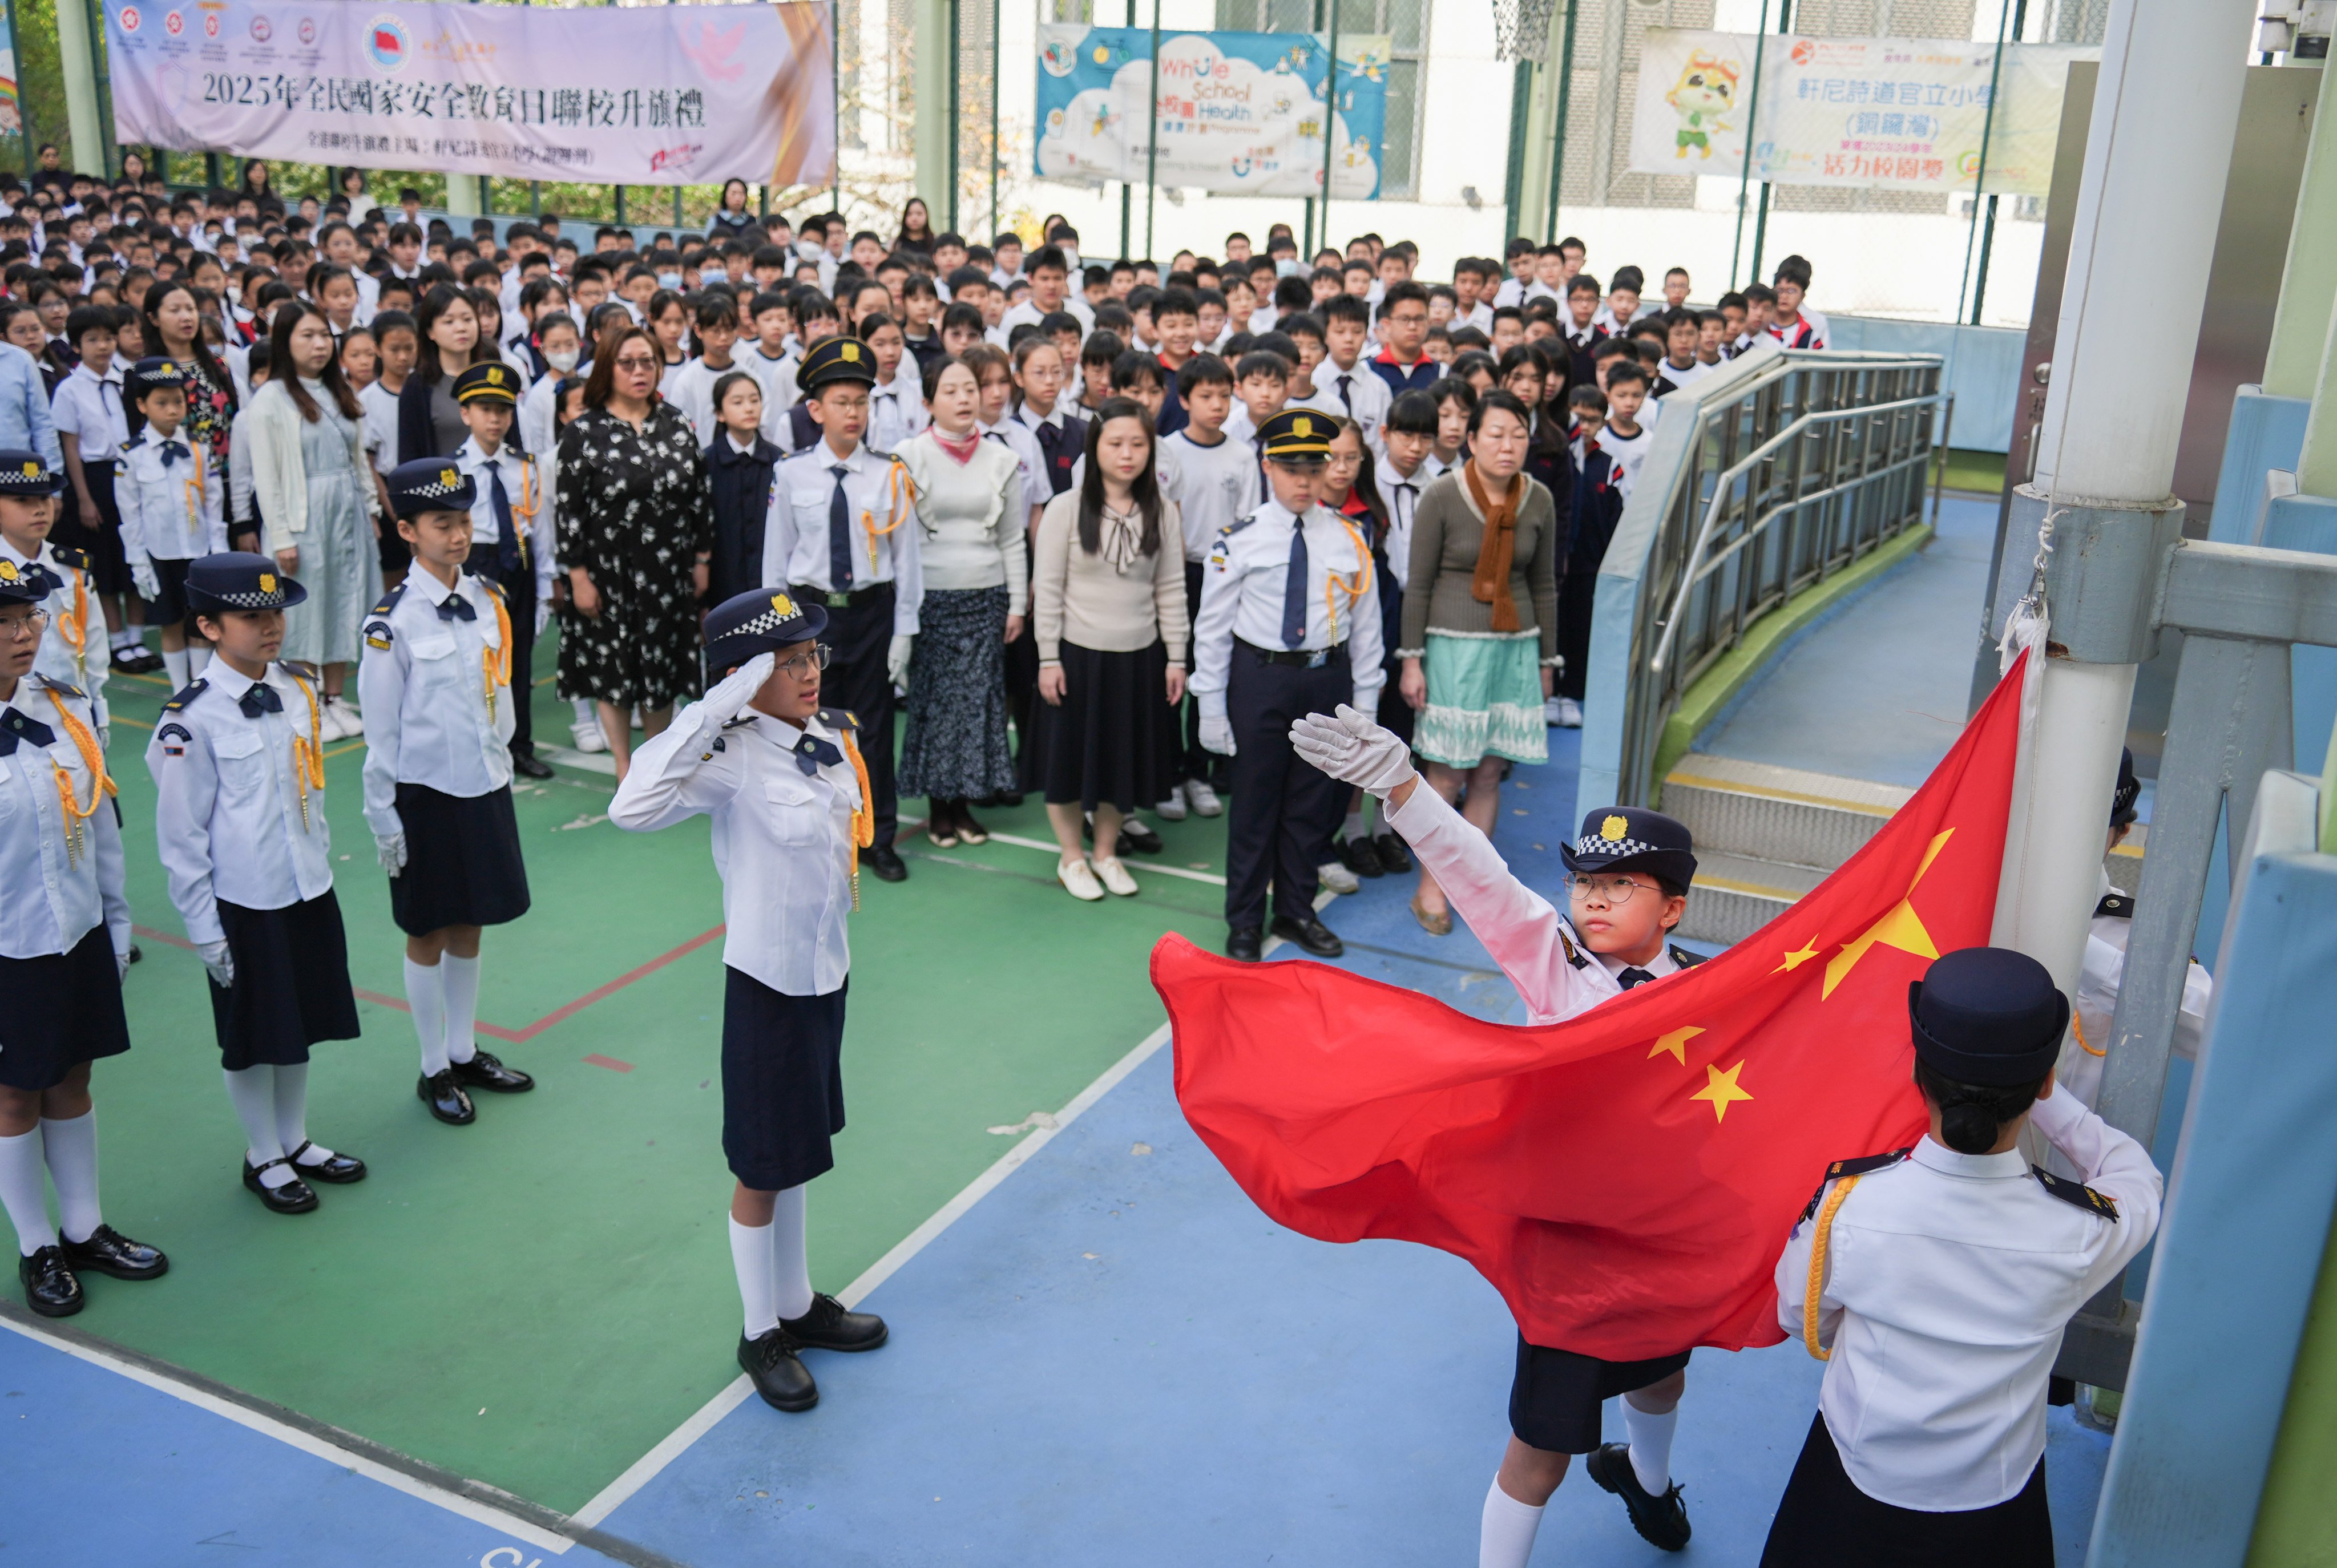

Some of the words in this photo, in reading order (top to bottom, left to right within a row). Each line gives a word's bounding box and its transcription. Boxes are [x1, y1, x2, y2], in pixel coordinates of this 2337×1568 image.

[203, 71, 705, 128] 2025年全民國家安全教育日聯校升旗禮
[1192, 81, 1252, 102] School
[1198, 102, 1252, 122] Health
